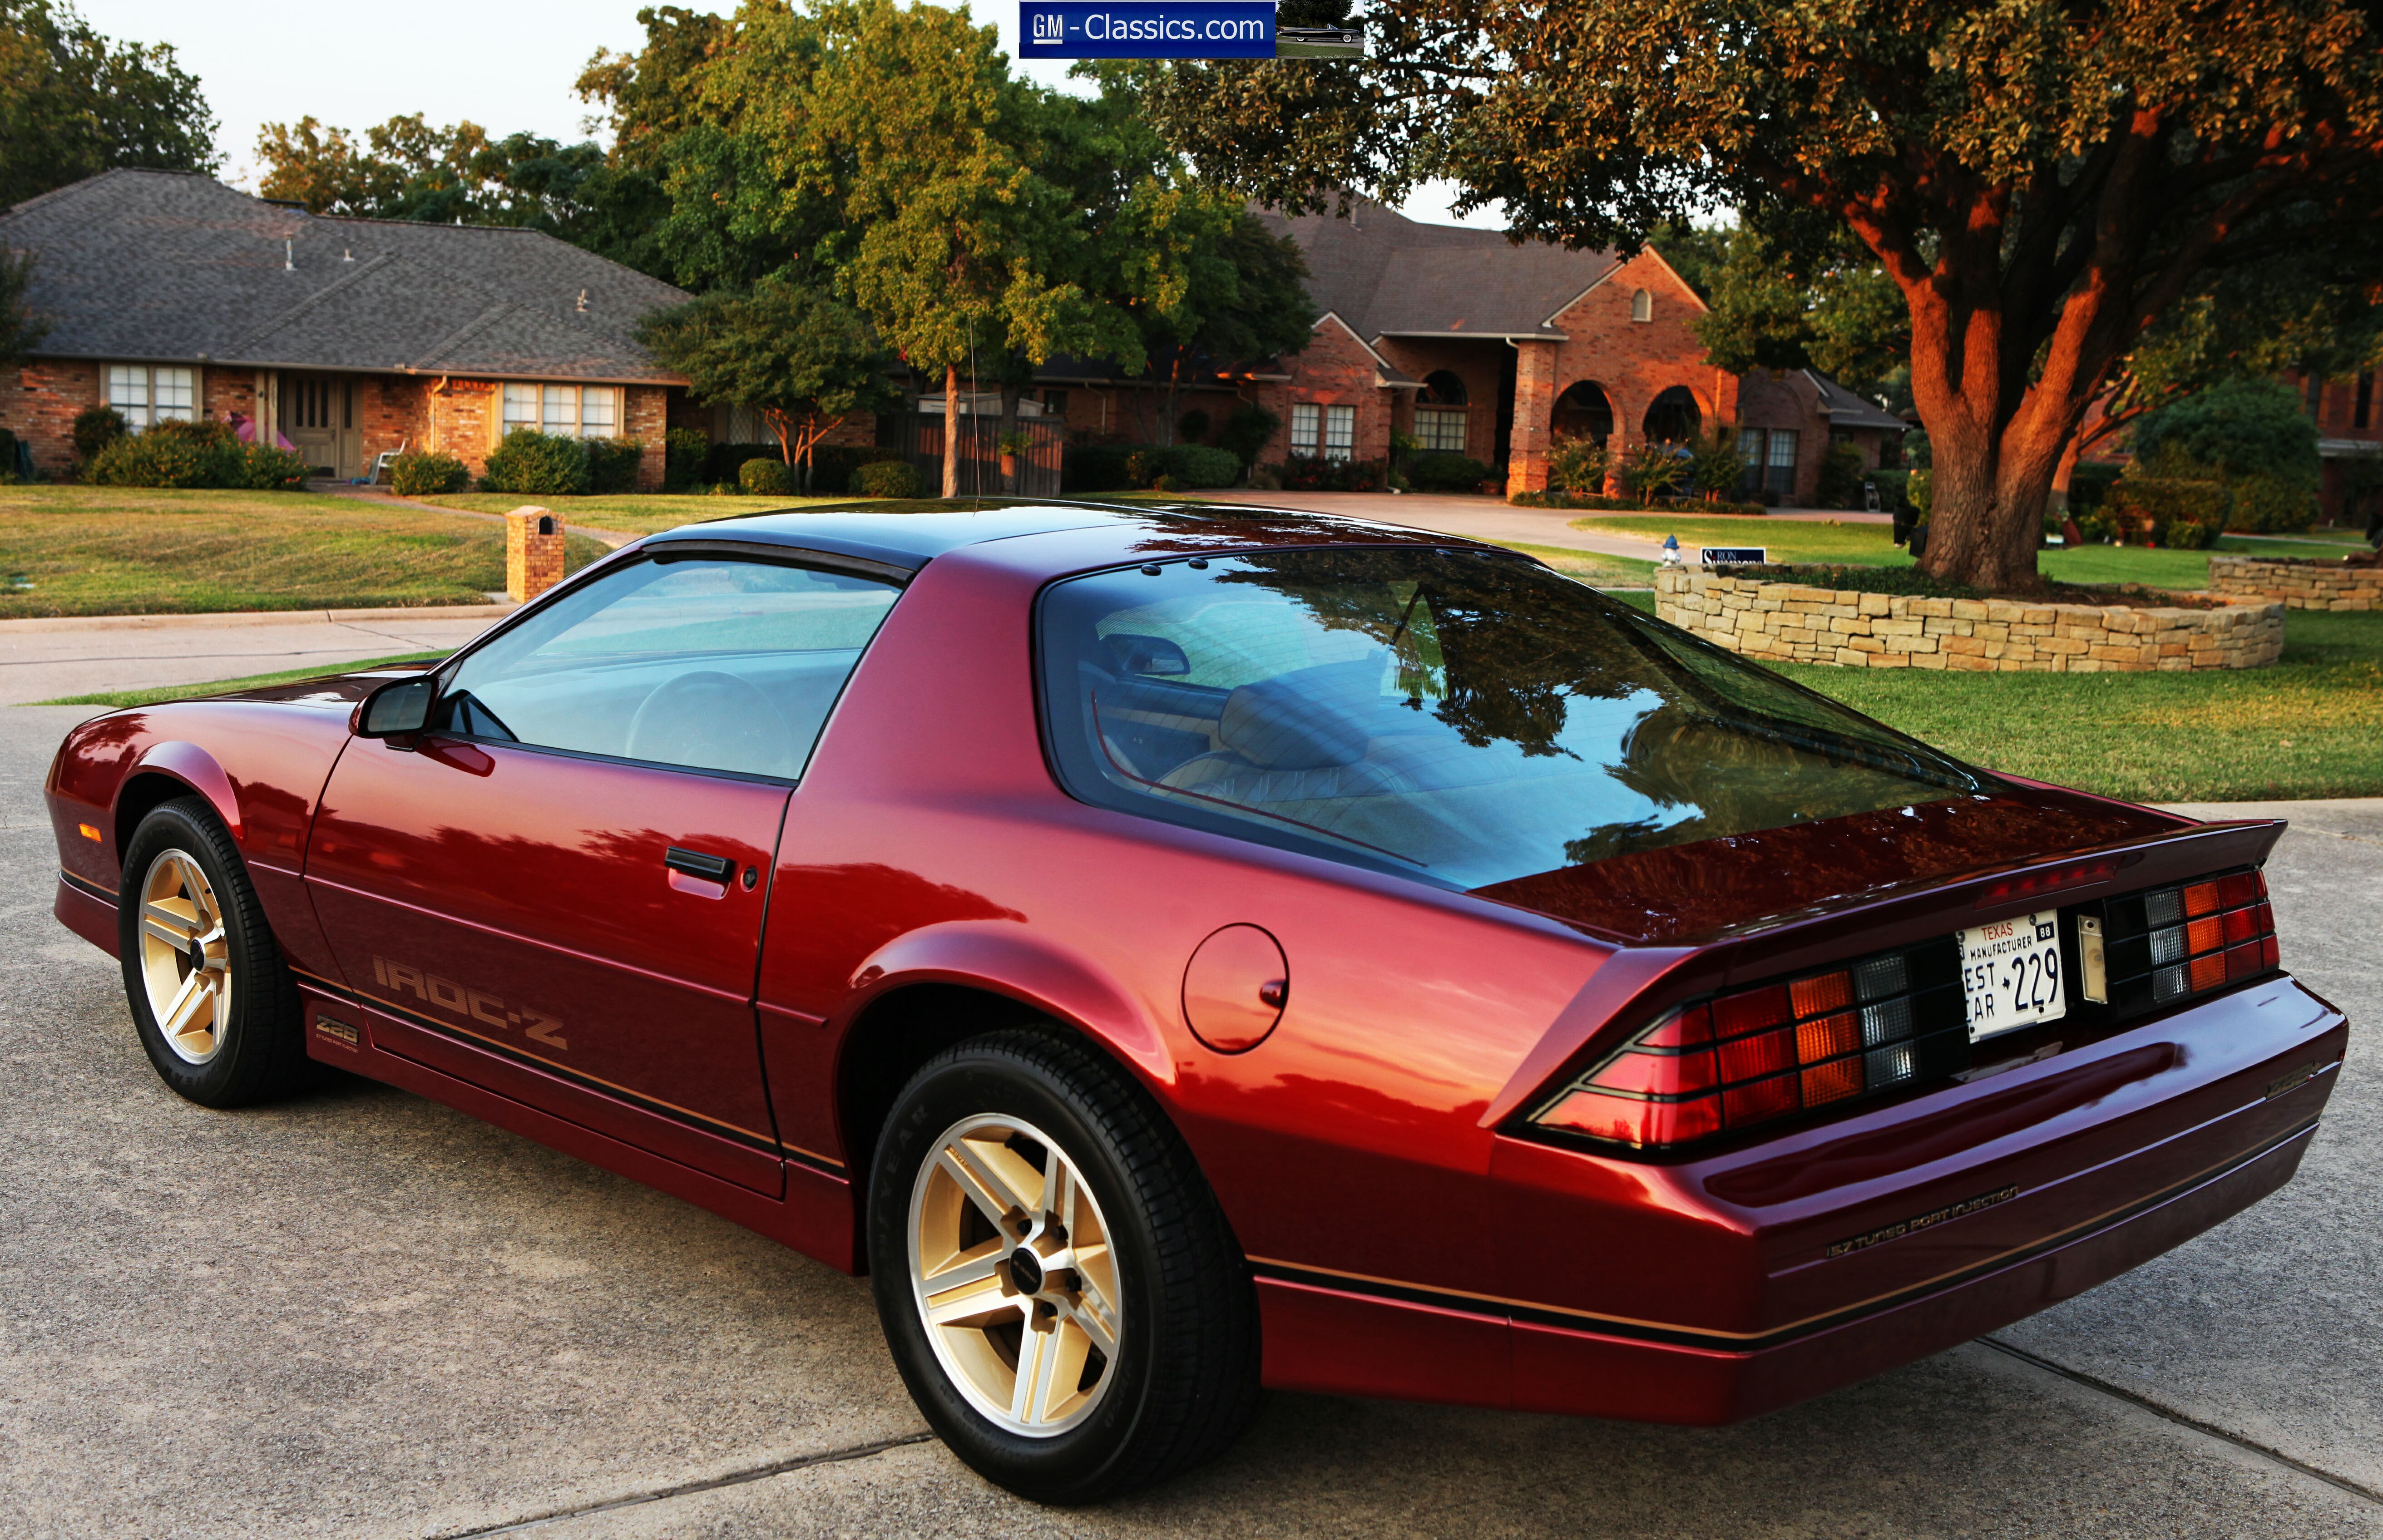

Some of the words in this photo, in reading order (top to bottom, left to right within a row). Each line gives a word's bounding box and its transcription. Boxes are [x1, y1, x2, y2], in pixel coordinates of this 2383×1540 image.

[1717, 551, 1736, 560] RON
[1982, 923, 2013, 941] TEXAS
[2040, 926, 2050, 937] 88
[1970, 935, 2032, 961] MANUFACTURER
[2012, 948, 2058, 1012] 229
[373, 954, 568, 1050] IROC-Z
[316, 1015, 358, 1043] Z28
[1855, 1224, 1905, 1248] TUNED
[1911, 1209, 1949, 1230] PORT
[1953, 1186, 2019, 1217] INJECTION
